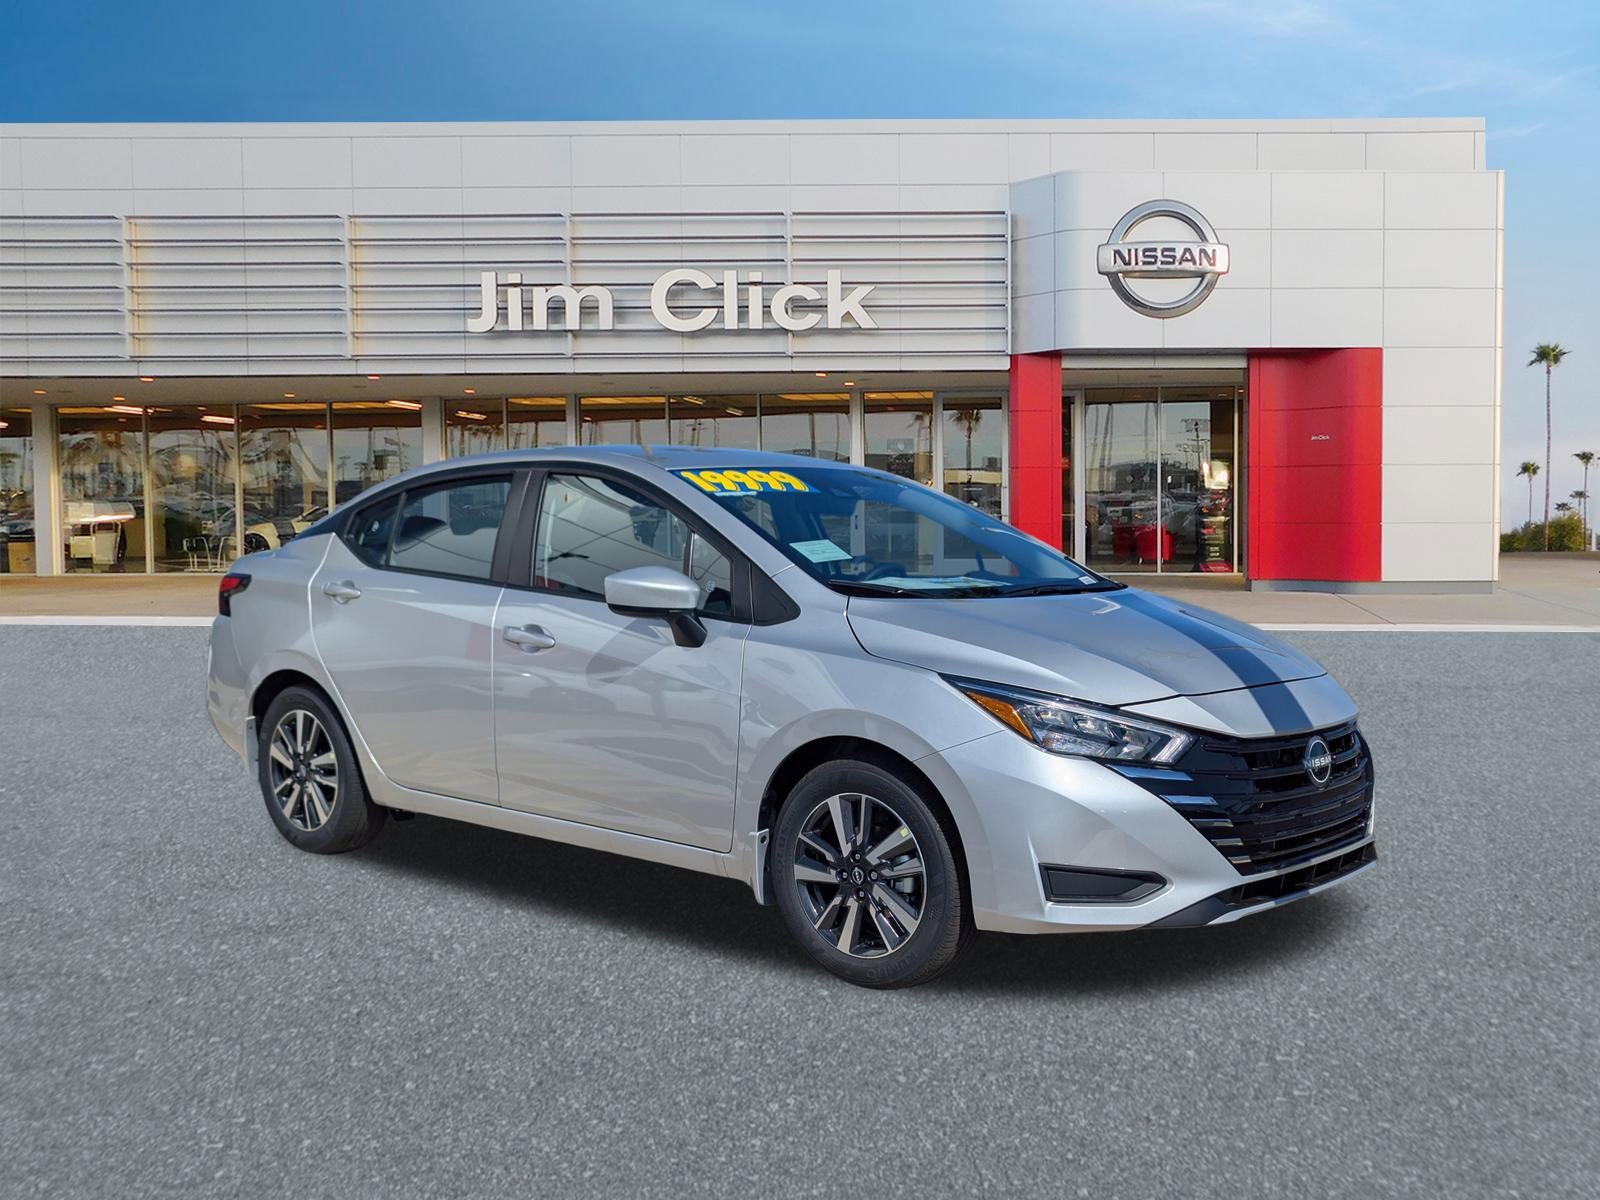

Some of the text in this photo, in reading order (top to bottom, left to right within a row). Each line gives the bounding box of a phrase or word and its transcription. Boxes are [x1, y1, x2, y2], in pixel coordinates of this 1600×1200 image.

[1113, 247, 1217, 267] NISSAN
[467, 269, 879, 332] Jim Click
[679, 470, 809, 492] 19999
[1304, 754, 1331, 768] NISSAN
